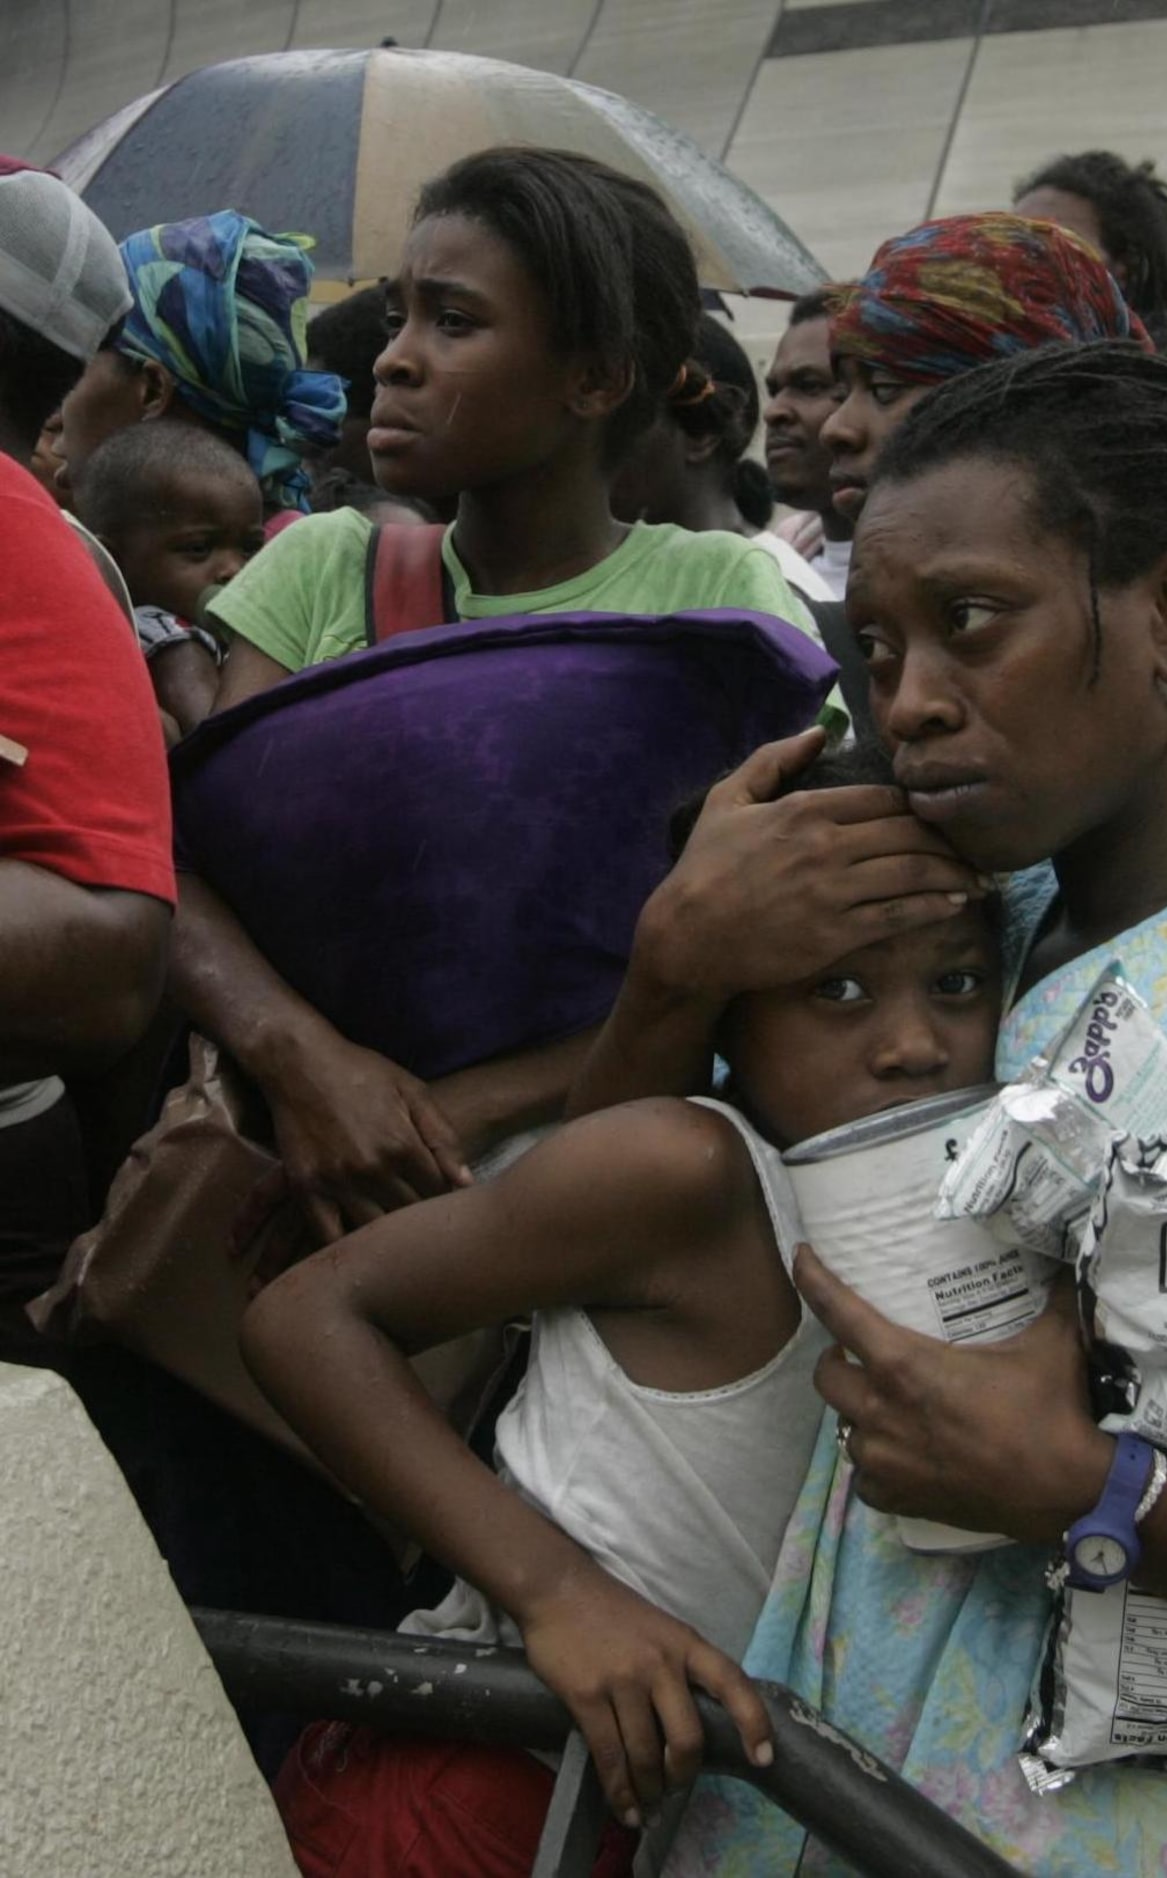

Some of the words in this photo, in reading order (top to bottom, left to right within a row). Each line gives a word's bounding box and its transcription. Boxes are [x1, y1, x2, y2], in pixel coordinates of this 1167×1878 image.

[927, 1266, 973, 1288] CONTAINS
[934, 1277, 991, 1301] Nutrition
[992, 1265, 1024, 1283] Facts
